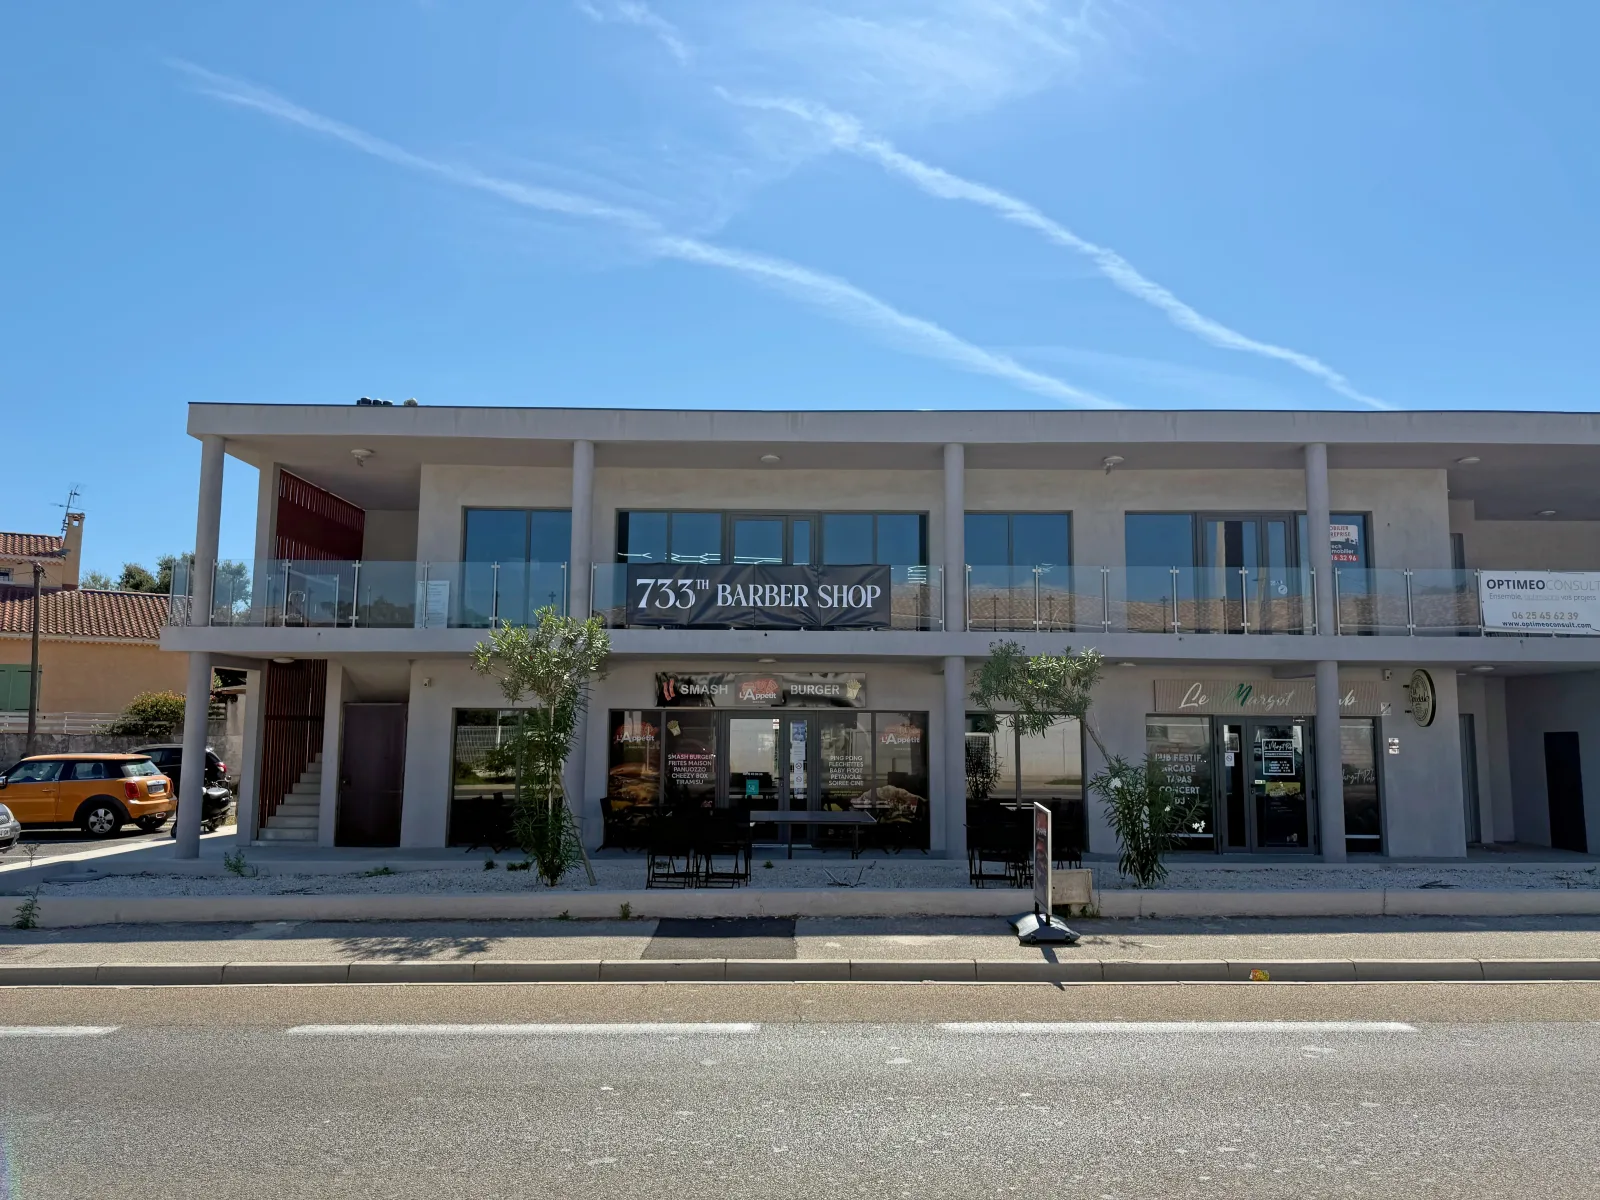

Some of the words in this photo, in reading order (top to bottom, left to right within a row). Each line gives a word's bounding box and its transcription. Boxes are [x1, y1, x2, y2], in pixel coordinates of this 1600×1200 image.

[716, 584, 808, 608] BARBER
[817, 584, 881, 608] SHOP
[1512, 612, 1523, 620] 06
[1526, 612, 1536, 620] 25
[1540, 612, 1551, 620] 45
[1554, 612, 1565, 620] 62
[1567, 612, 1579, 620] 39
[680, 684, 728, 695] SMASH
[790, 684, 840, 695] BURGER
[1178, 682, 1210, 708] Le
[1173, 753, 1202, 762] FESTIF
[1162, 764, 1196, 772] ARCADE
